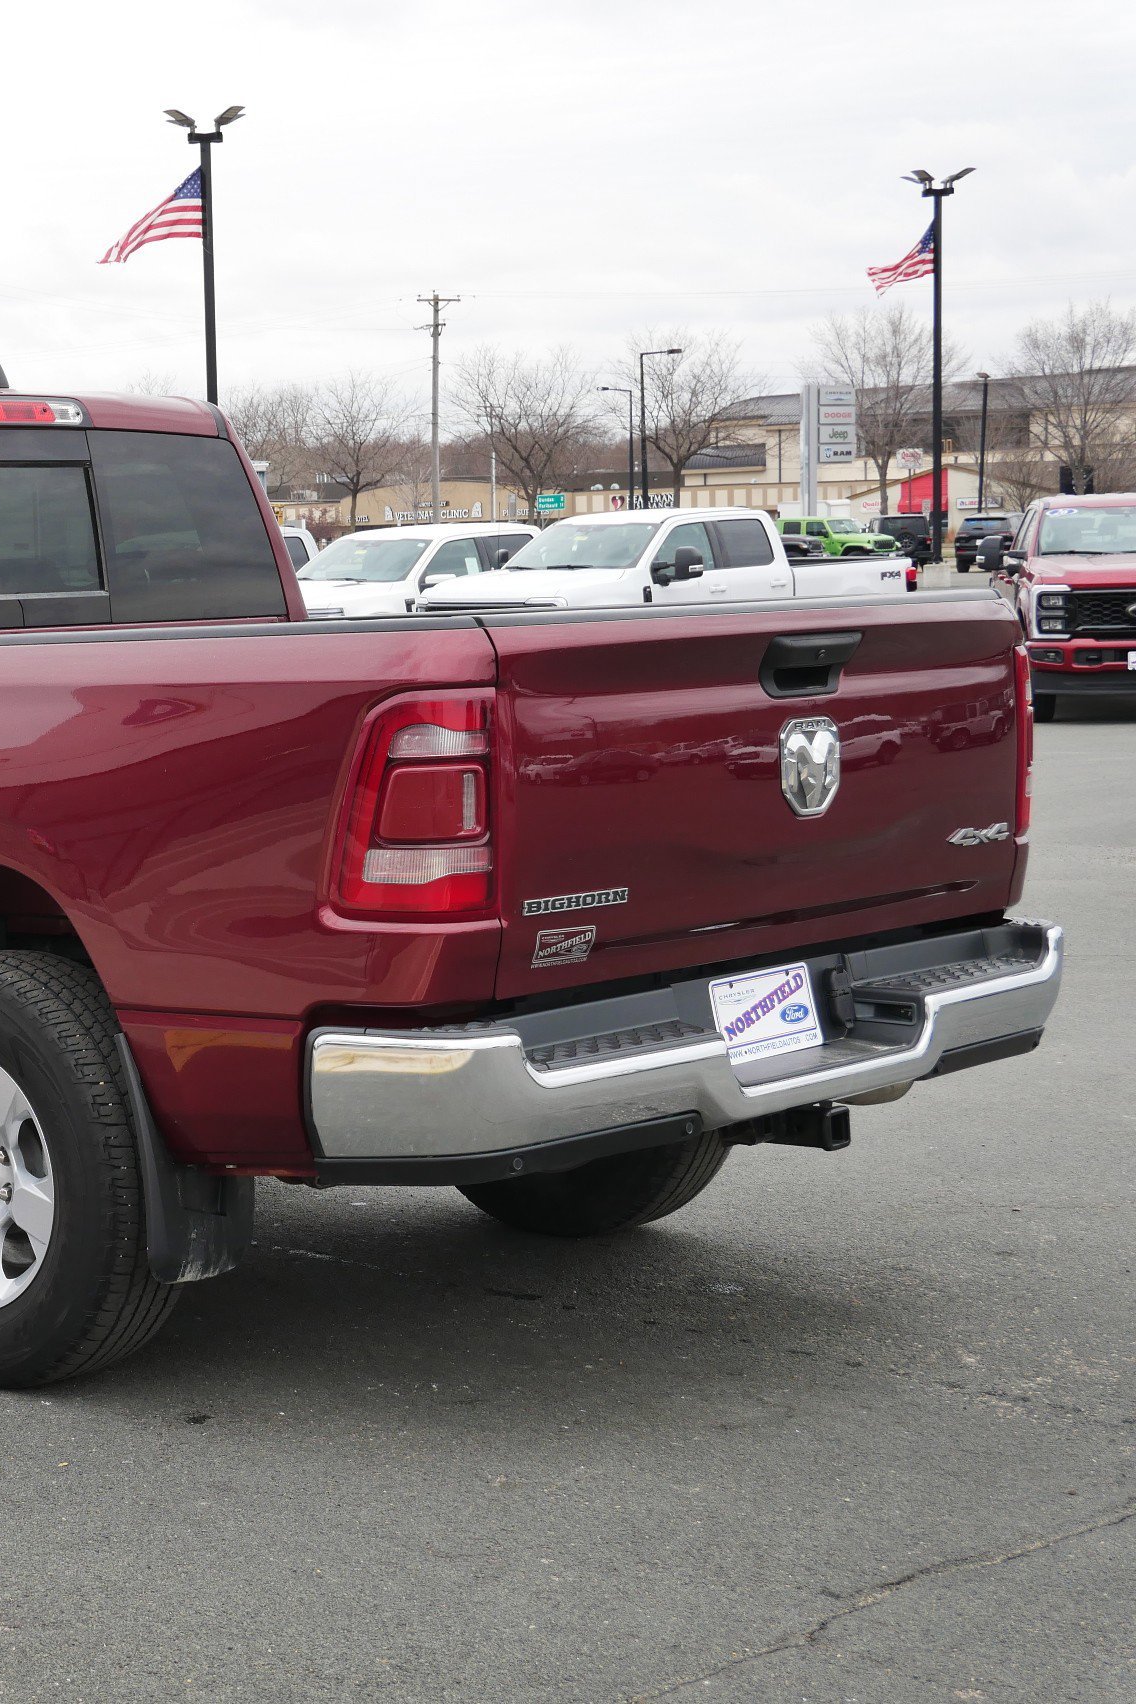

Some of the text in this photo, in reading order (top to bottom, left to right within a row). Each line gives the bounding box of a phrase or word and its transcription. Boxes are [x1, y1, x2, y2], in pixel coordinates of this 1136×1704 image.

[829, 428, 848, 440] Jeep
[441, 509, 469, 519] CLINIC
[881, 571, 901, 581] FX4
[794, 720, 827, 730] RAM
[523, 888, 628, 916] BIGHORN
[538, 931, 592, 959] NORTHFIELD
[719, 988, 755, 1001] CHRYSLER
[724, 972, 804, 1042] NORTHFIELD
[785, 1004, 805, 1021] Ford
